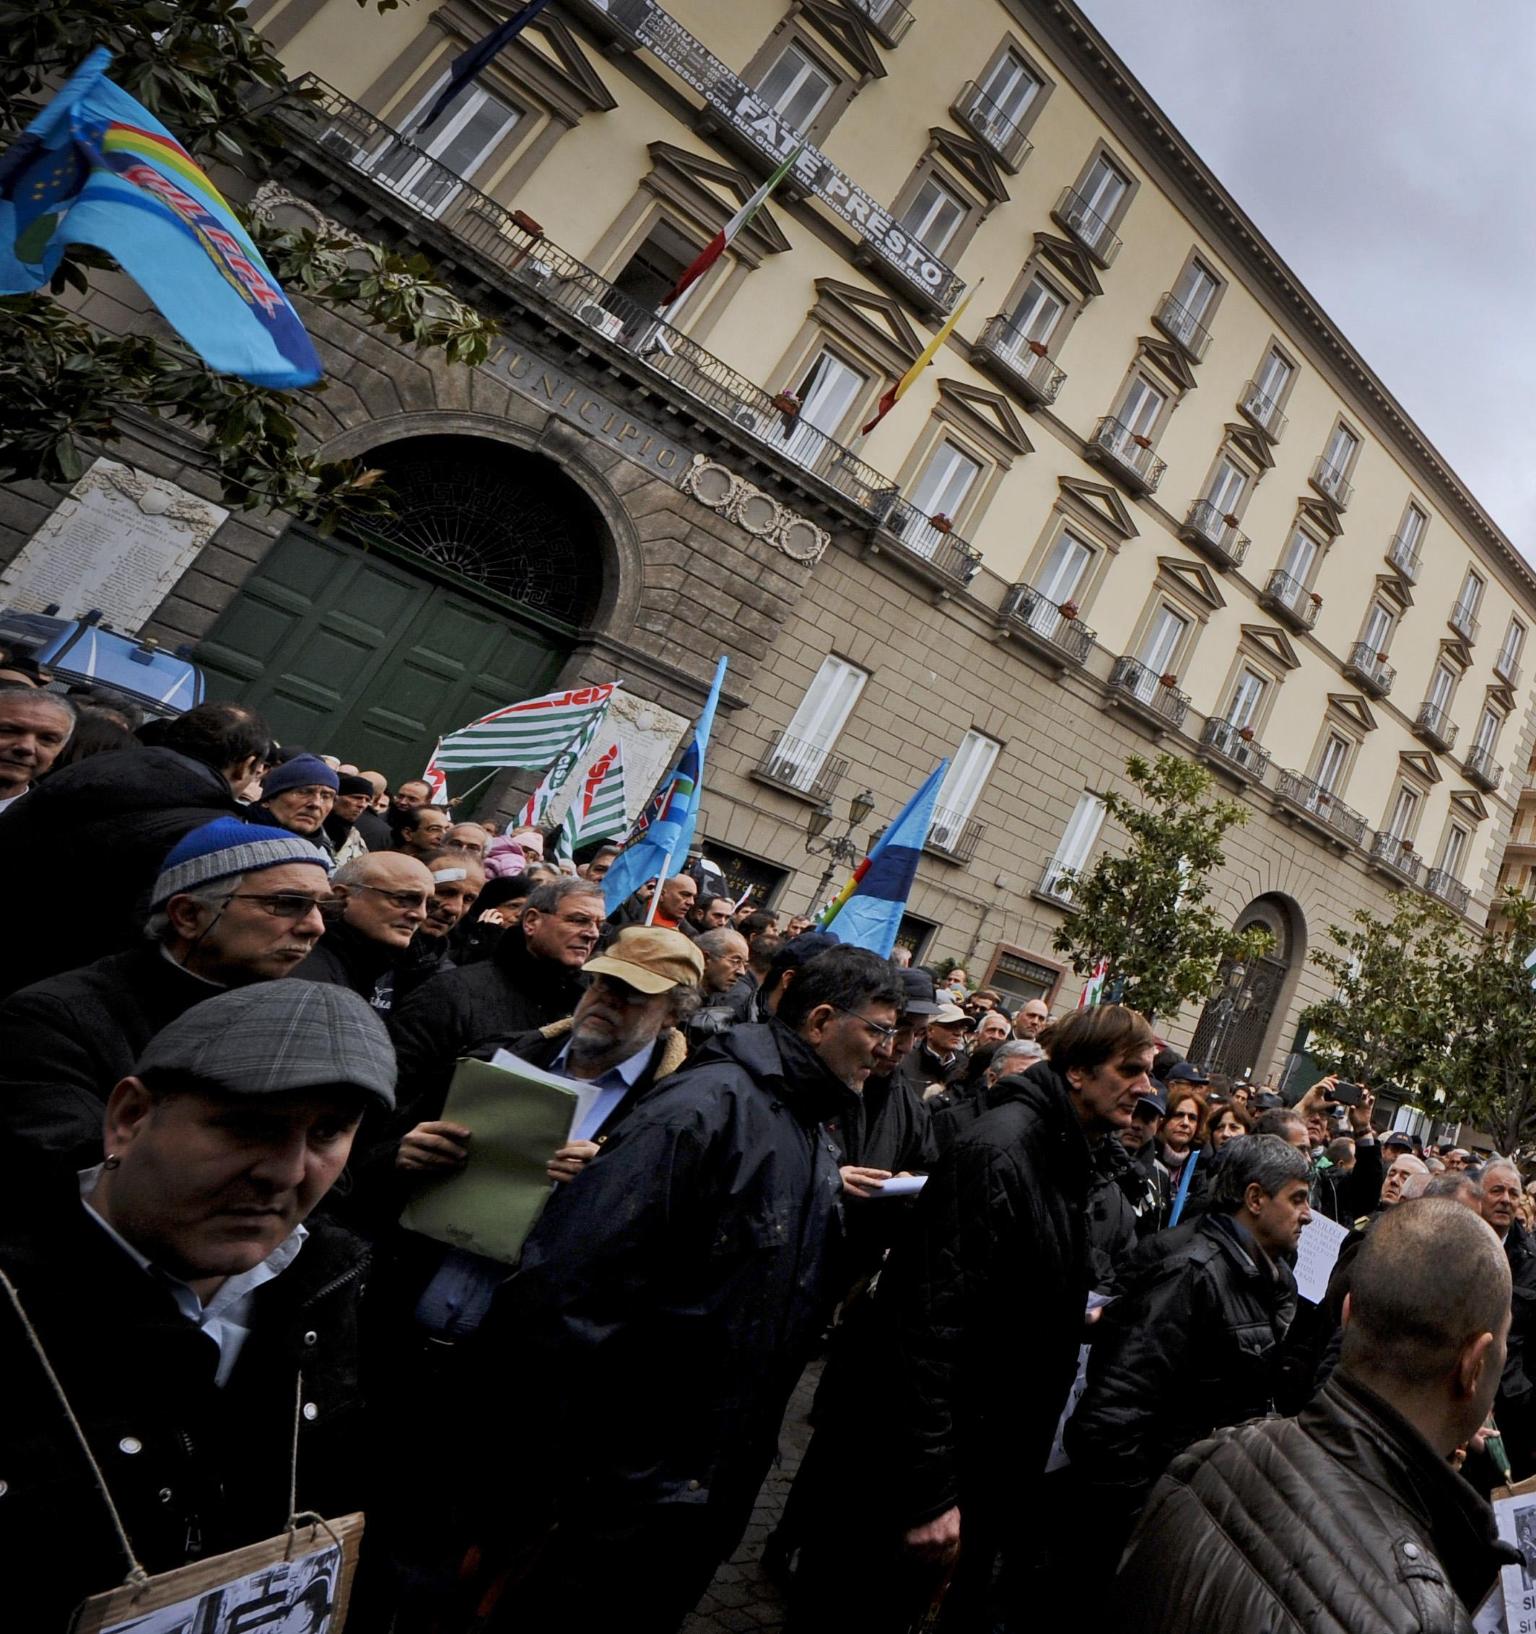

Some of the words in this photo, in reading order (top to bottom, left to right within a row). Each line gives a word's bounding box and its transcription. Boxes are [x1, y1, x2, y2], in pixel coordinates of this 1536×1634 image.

[647, 21, 669, 40] 2011
[650, 14, 672, 35] 2010
[634, 29, 653, 48] UN
[653, 46, 705, 92] DECESSO
[705, 91, 732, 117] OGNI
[732, 116, 756, 138] DUE
[755, 135, 787, 165] GIORN
[811, 184, 850, 222] SUICIDIO
[851, 219, 875, 243] OGNI
[906, 267, 936, 296] GIORNI
[706, 55, 750, 94] MORTI
[751, 92, 792, 131] NELLE
[843, 173, 895, 224] ITALIANE
[735, 95, 822, 180] FATE
[825, 175, 943, 287] PRESTO
[488, 344, 677, 470] UNICIPIO
[1520, 1620, 1531, 1633] Si
